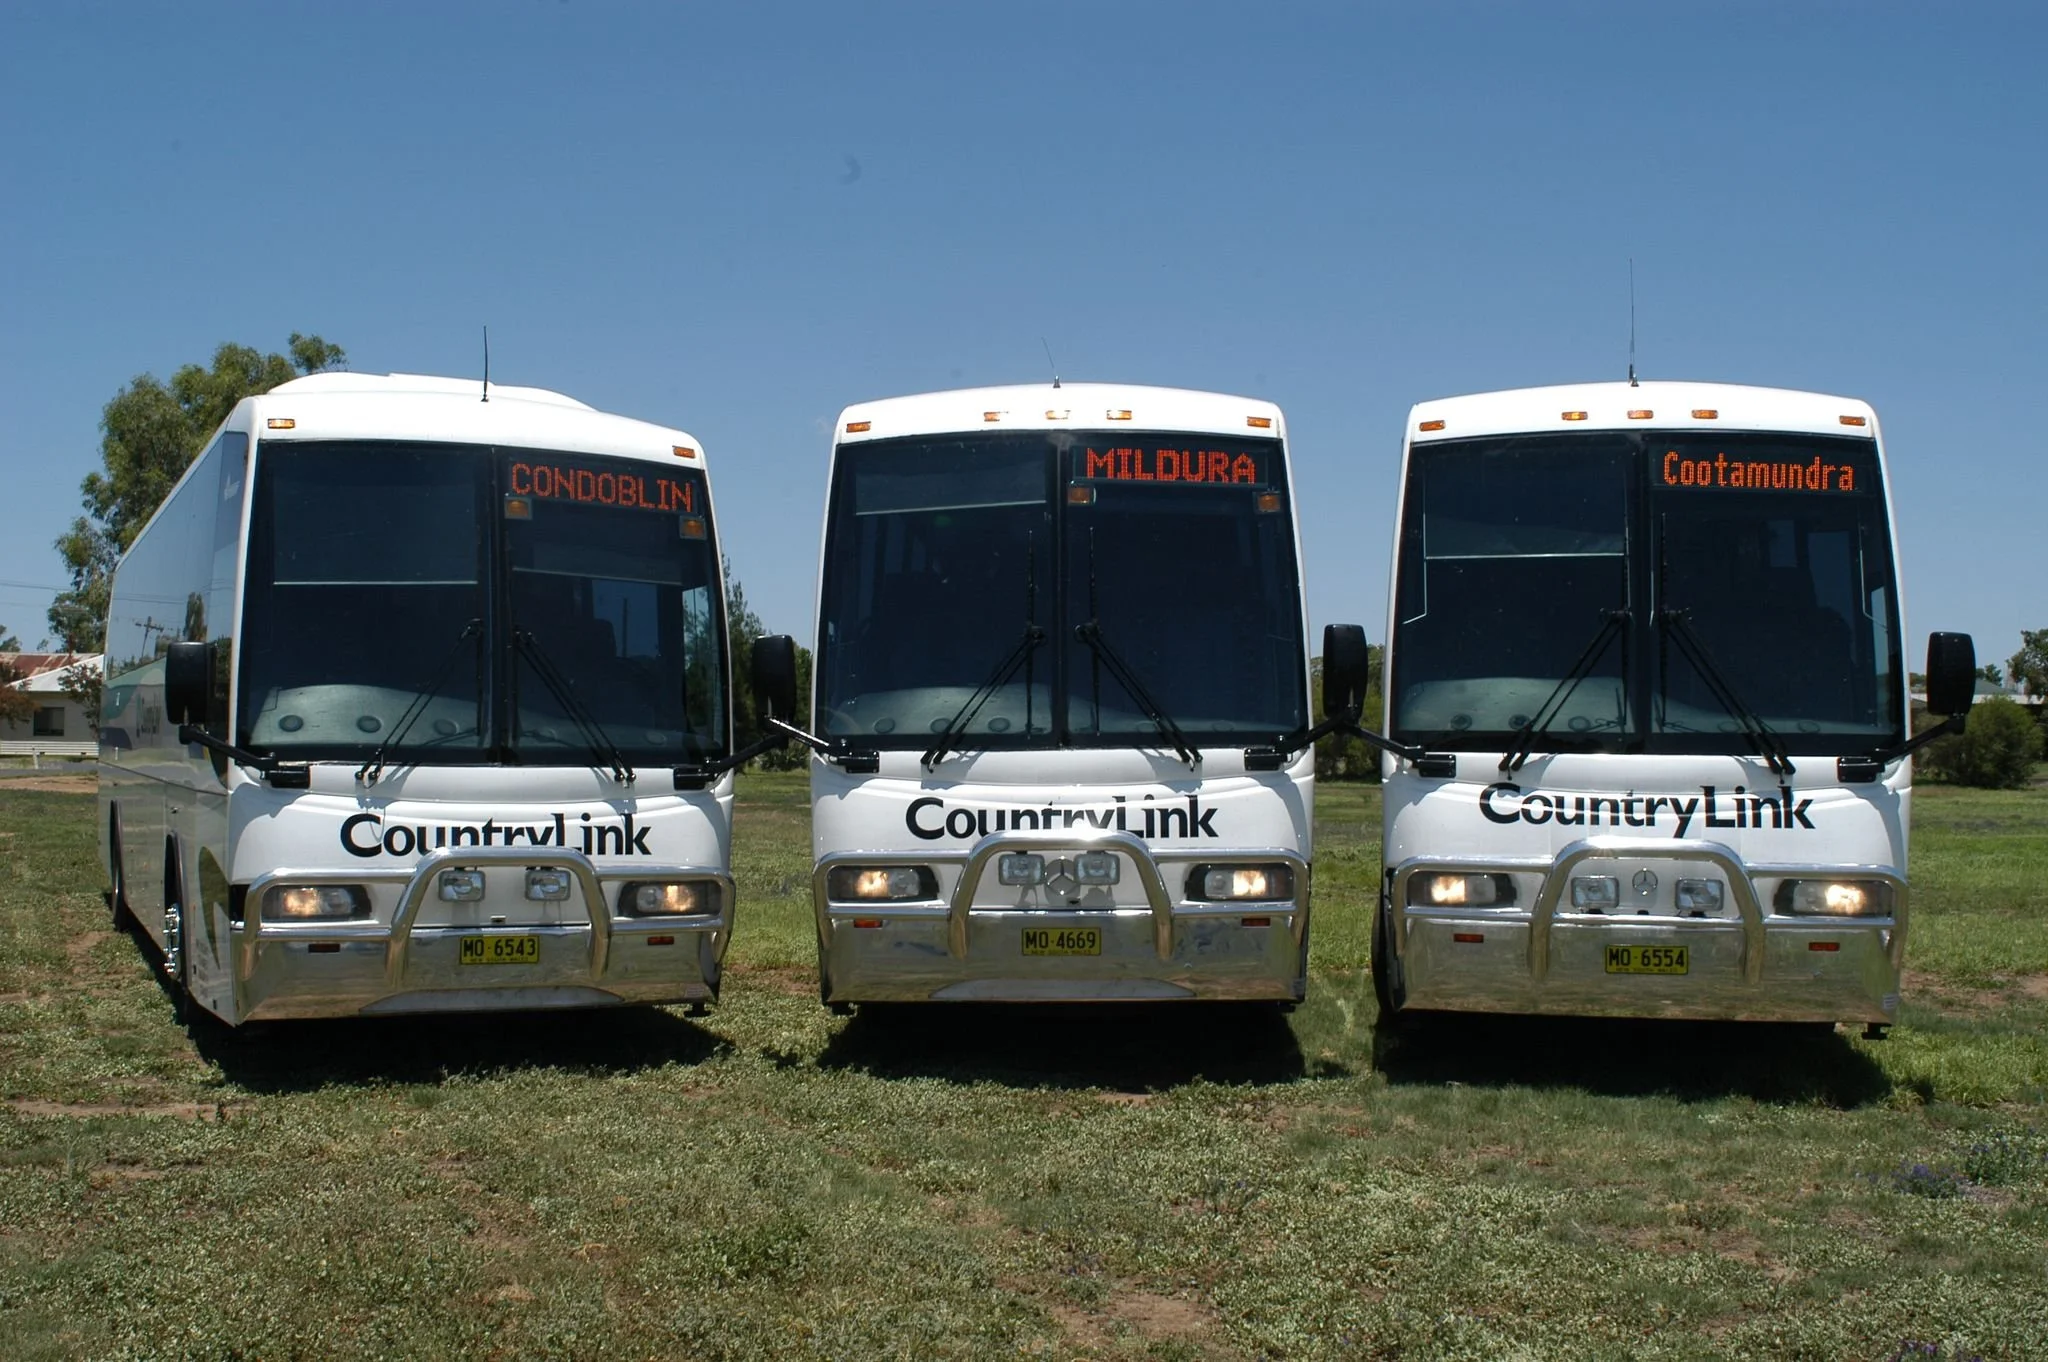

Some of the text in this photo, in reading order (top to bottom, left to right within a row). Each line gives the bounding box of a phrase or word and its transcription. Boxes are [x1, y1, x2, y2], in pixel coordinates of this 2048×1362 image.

[511, 463, 692, 512] CONDOBLIN
[1086, 447, 1256, 484] MILDURA
[1663, 450, 1854, 491] Cootamundra
[1479, 782, 1815, 839] CountryLink
